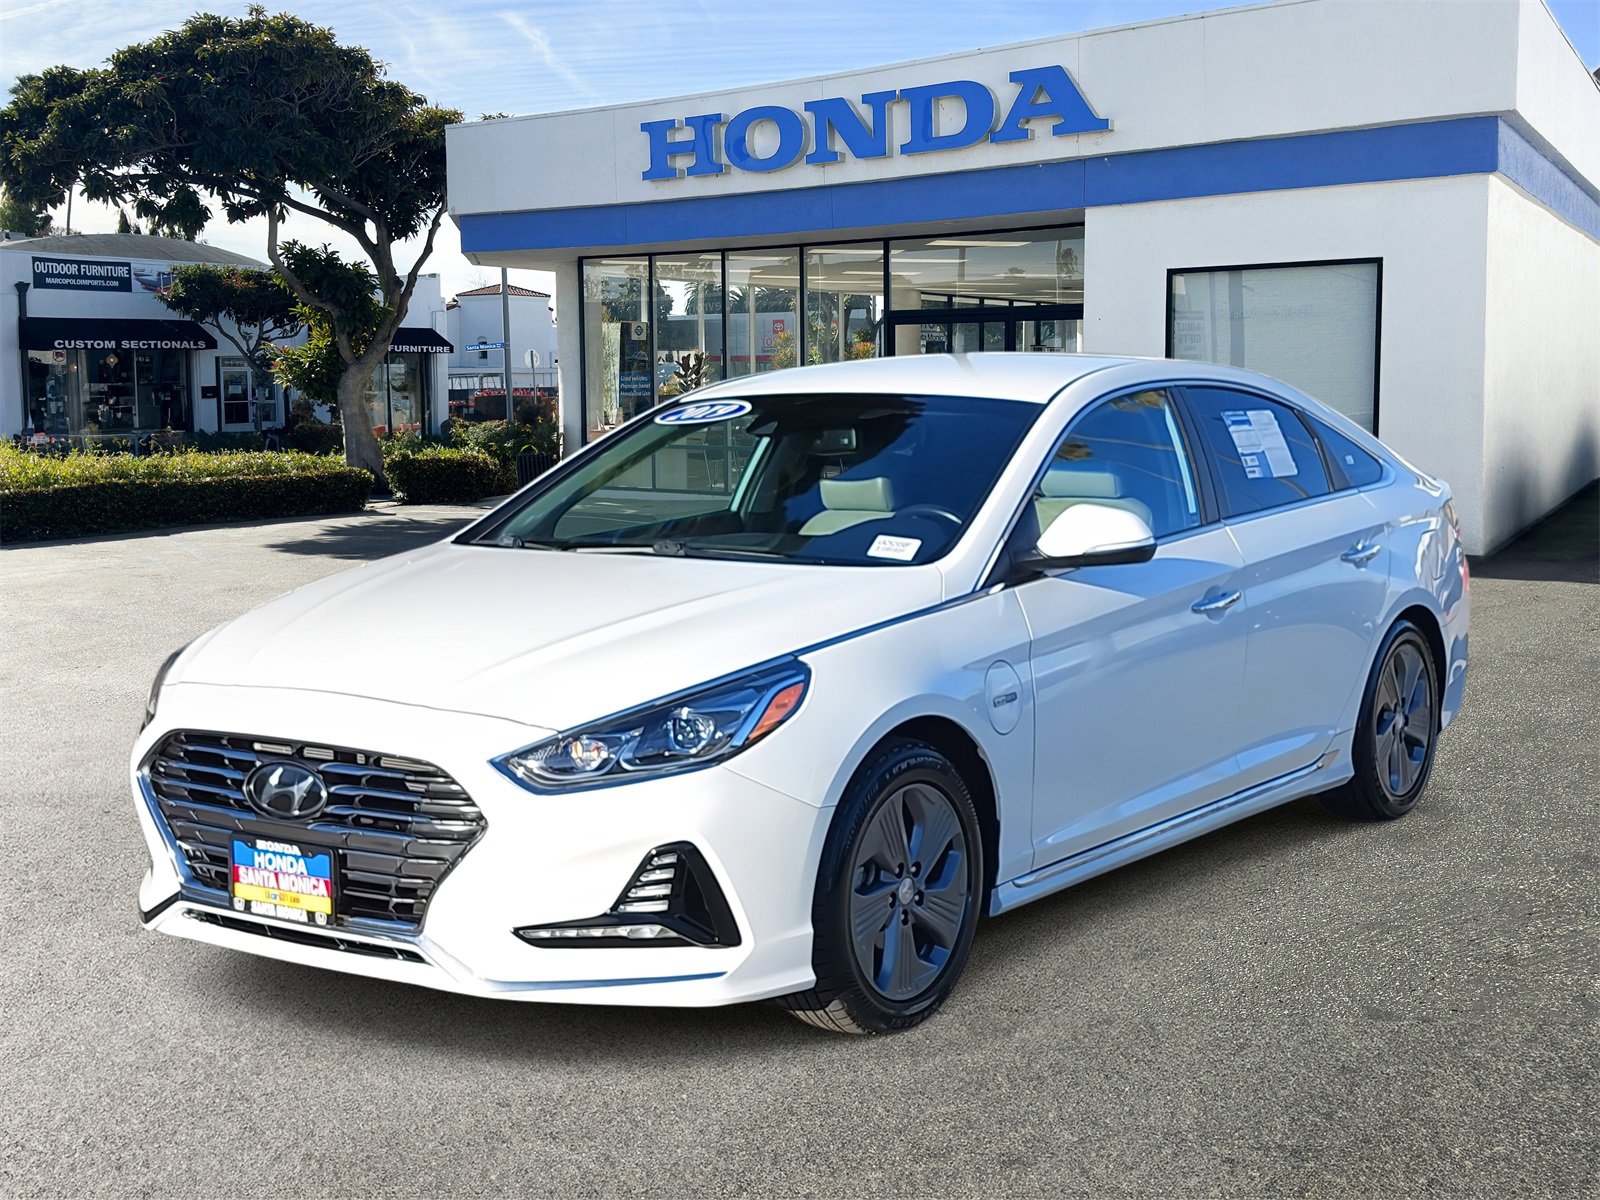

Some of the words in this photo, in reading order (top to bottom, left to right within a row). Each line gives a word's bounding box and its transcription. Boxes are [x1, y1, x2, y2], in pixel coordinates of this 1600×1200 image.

[640, 64, 1111, 181] HONDA
[34, 261, 79, 275] OUTDOOR
[80, 264, 130, 278] FURNITURE
[45, 277, 119, 287] MARCOPOLOIMPORTS.COM
[54, 339, 116, 349] CUSTOM
[121, 340, 206, 350] SECTIONALS
[388, 344, 451, 353] FURNITURE
[254, 851, 308, 876] HONDA
[238, 867, 279, 890] SANTA
[278, 873, 328, 898] MONICA
